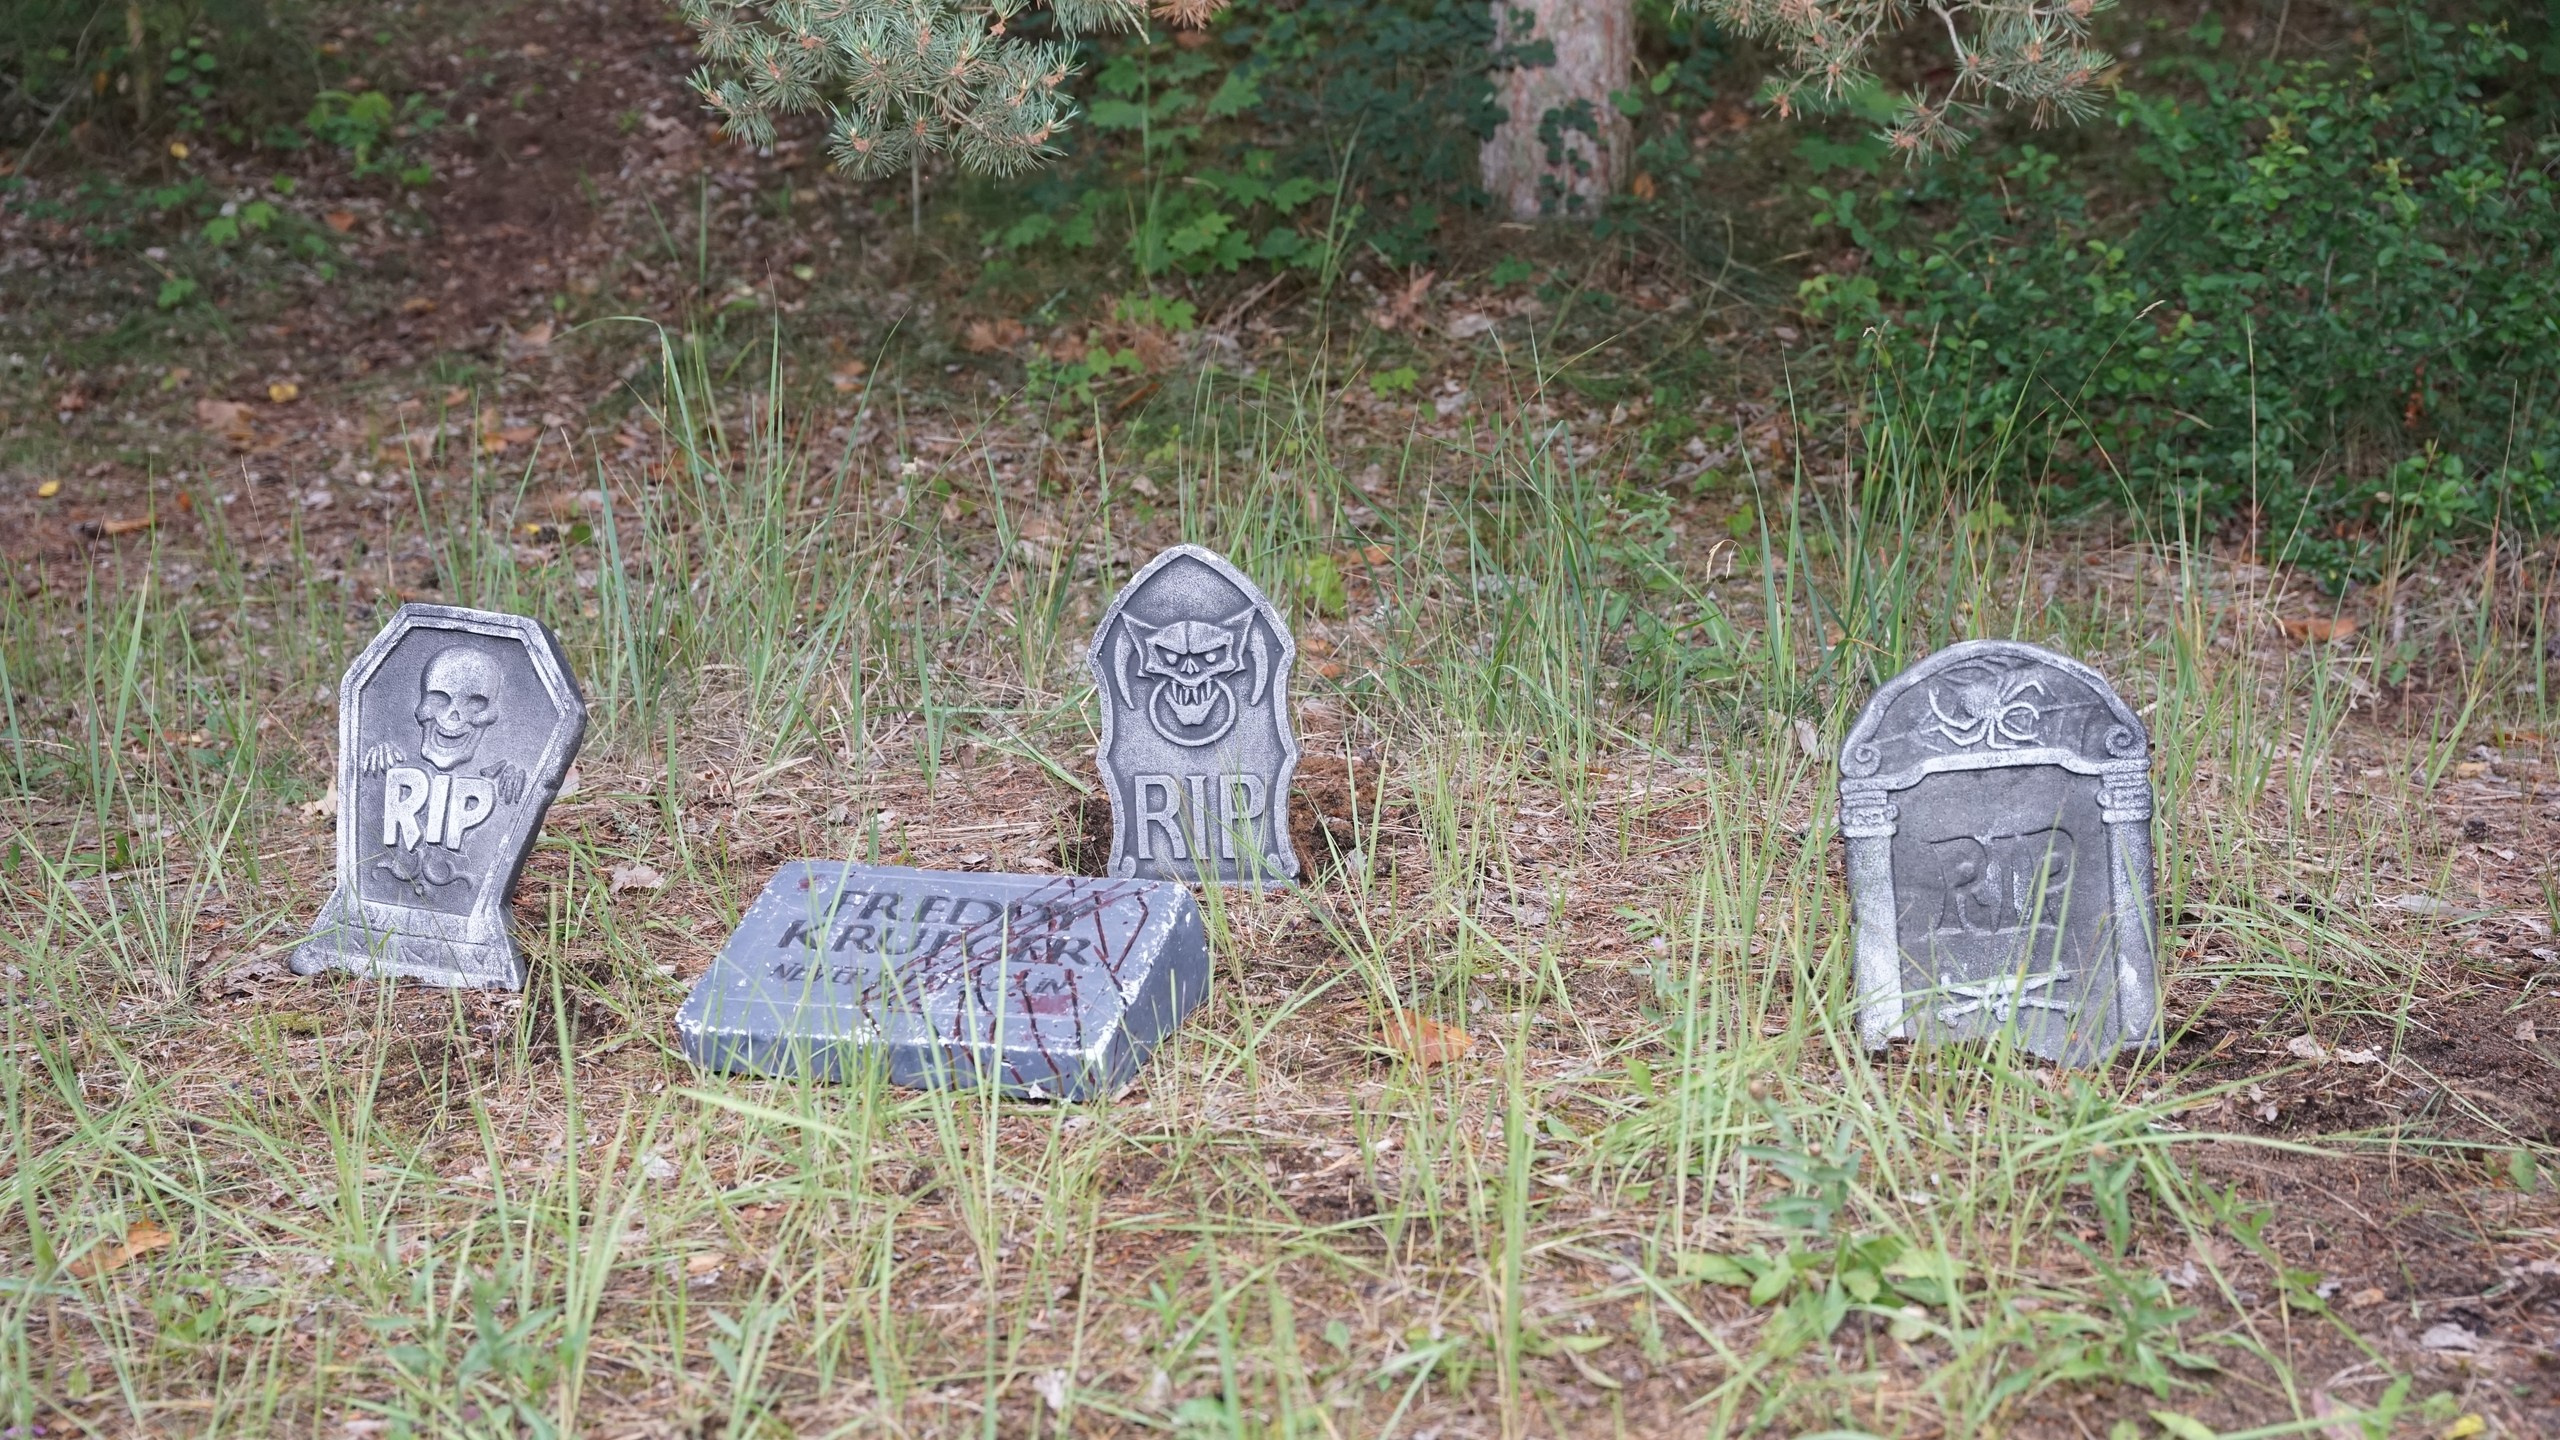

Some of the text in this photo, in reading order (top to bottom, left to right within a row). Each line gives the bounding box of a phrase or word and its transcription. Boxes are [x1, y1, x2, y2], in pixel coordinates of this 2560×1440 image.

[383, 767, 496, 852] RIP
[1133, 774, 1266, 860] RIP
[1923, 827, 2076, 936] RIP
